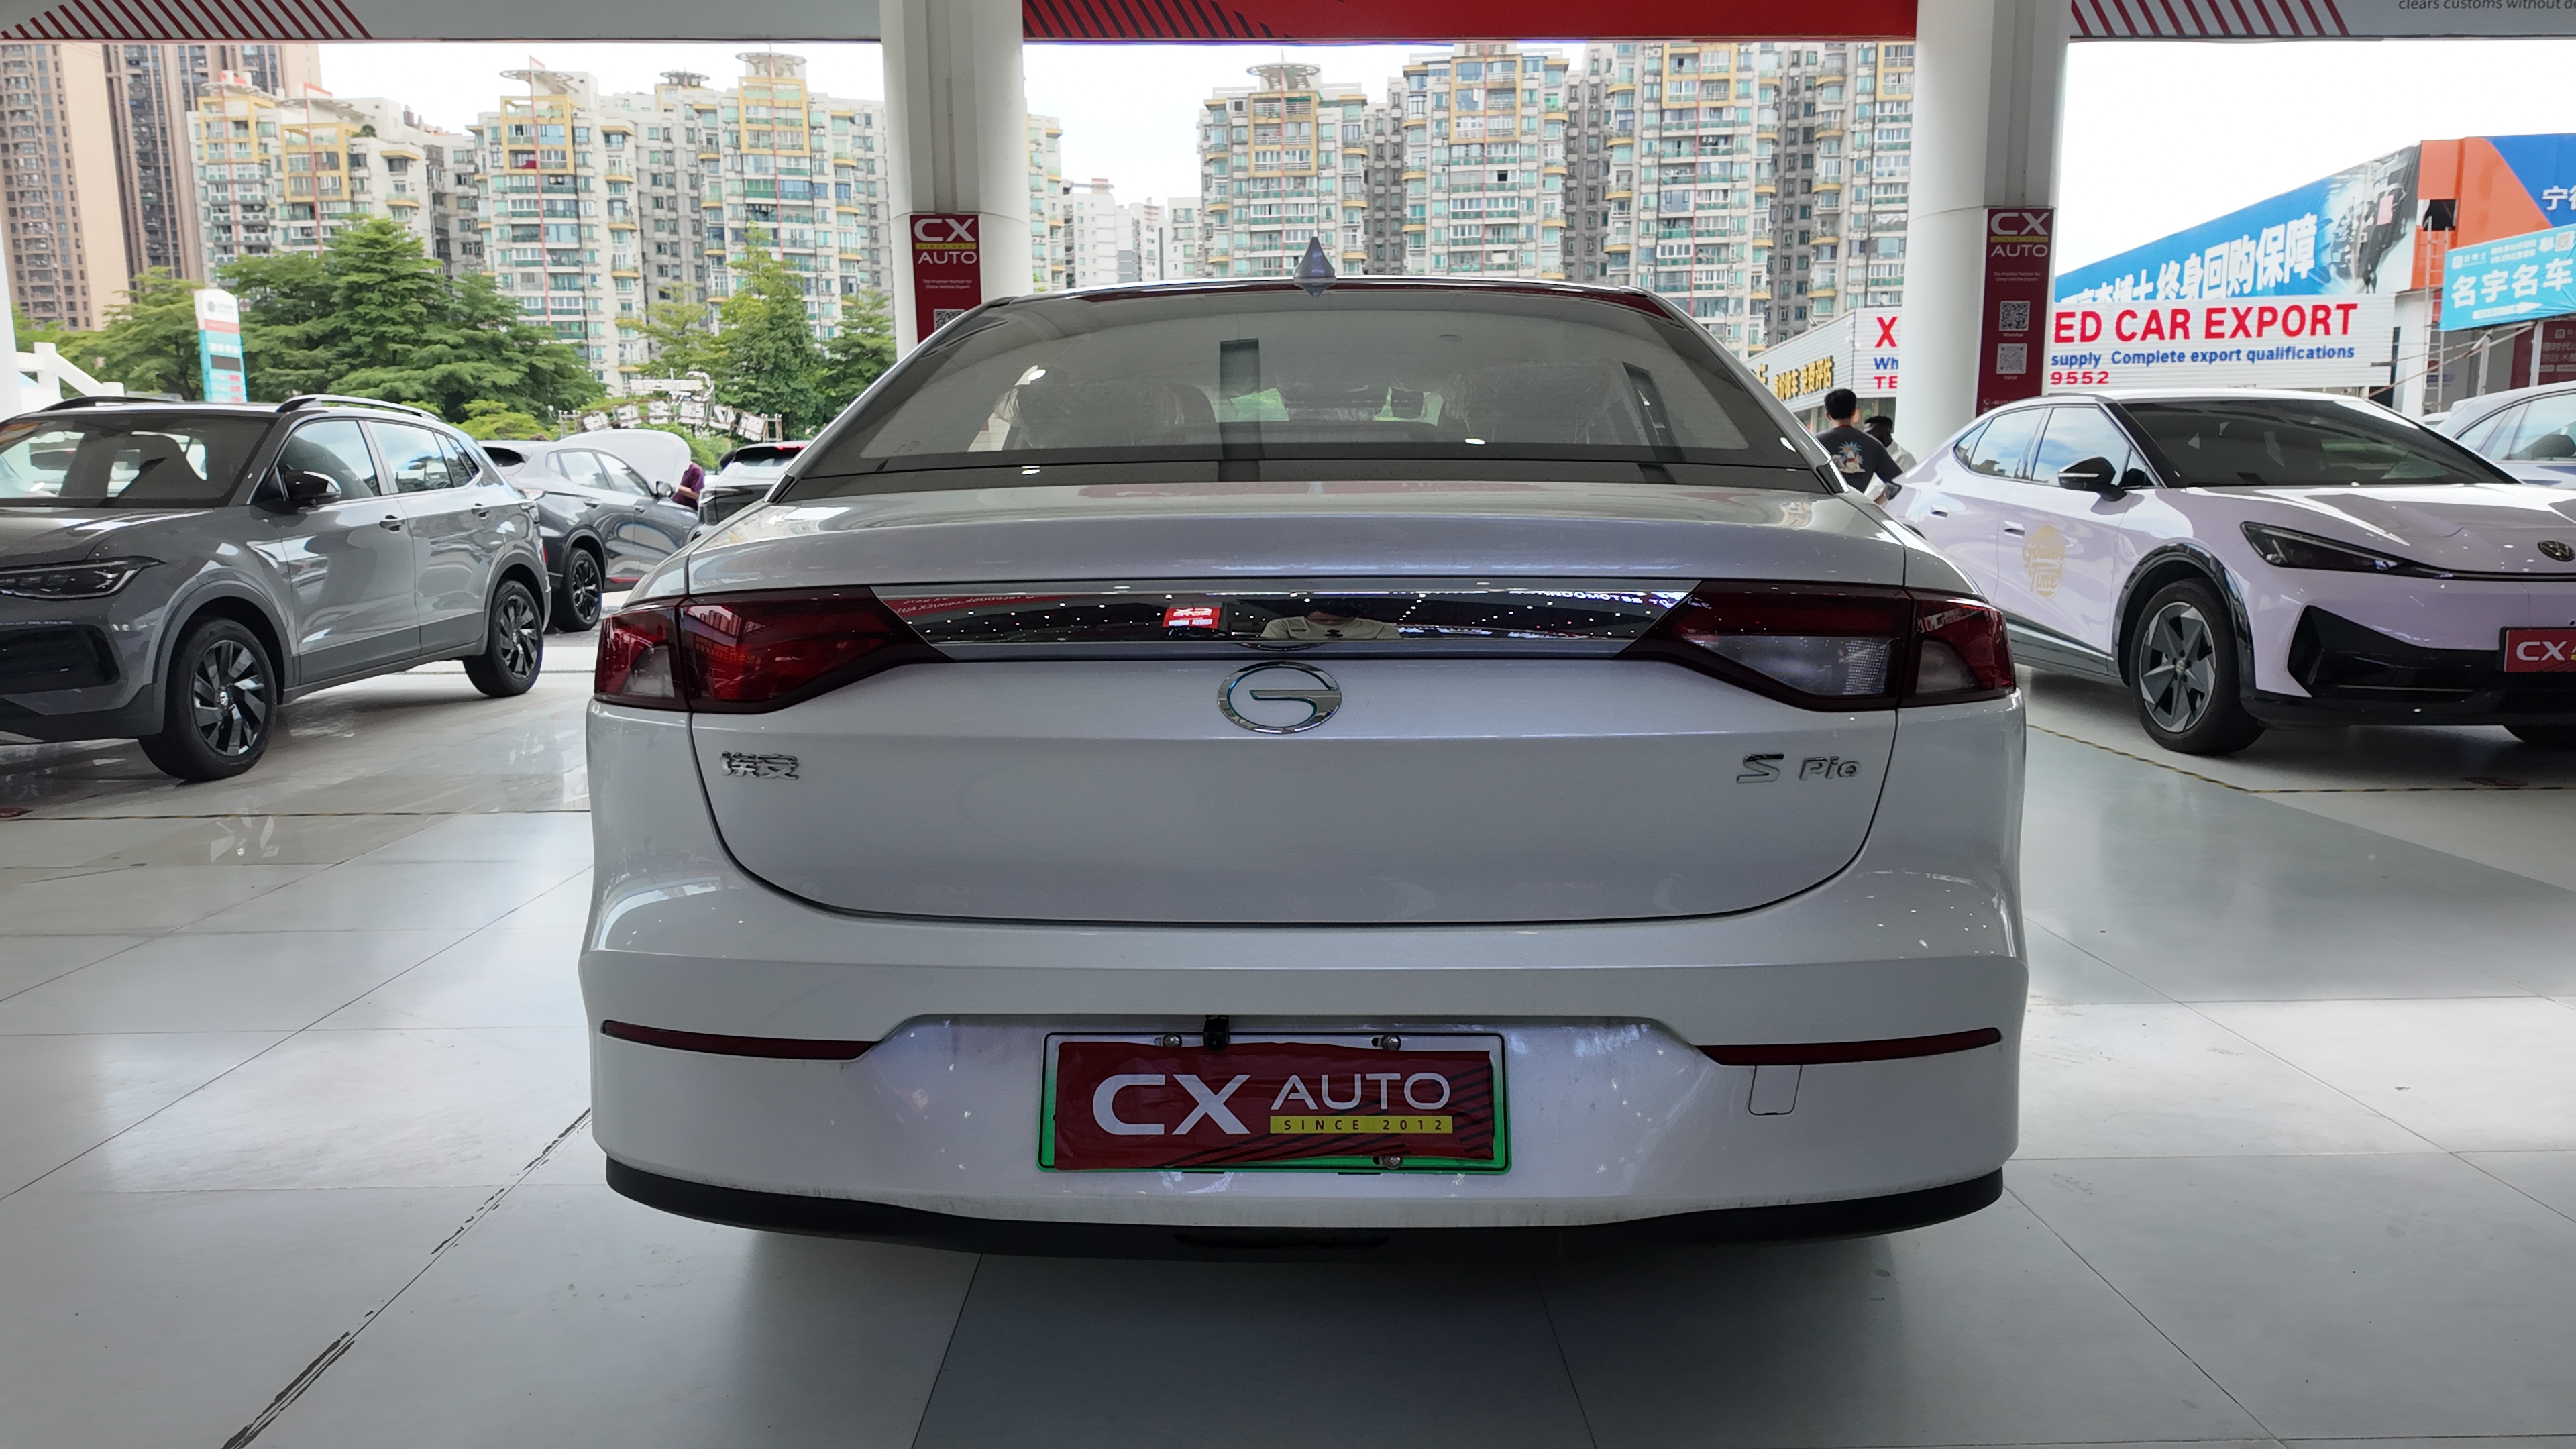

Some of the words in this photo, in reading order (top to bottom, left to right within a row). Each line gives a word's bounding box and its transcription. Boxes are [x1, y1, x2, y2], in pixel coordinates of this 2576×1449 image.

[2398, 0, 2440, 9] clears
[2443, 0, 2502, 9] customs
[2507, 0, 2561, 9] without
[914, 218, 975, 241] CX
[1991, 212, 2050, 235] CX
[918, 251, 977, 264] AUTO
[1990, 244, 2048, 257] AUTO
[2451, 258, 2573, 309] 名宇名车
[2054, 311, 2102, 343] ED
[2115, 309, 2191, 342] CAR
[2204, 303, 2358, 339] EXPORT
[1874, 357, 1899, 370] Wh
[2050, 352, 2102, 368] supply
[2111, 350, 2186, 367] Complete
[2190, 348, 2242, 366] export
[2246, 345, 2355, 364] qualifications
[1873, 376, 1898, 389] TE
[2516, 641, 2567, 661] CX
[1736, 753, 1785, 784] S
[1093, 1074, 1251, 1136] CX
[1270, 1072, 1450, 1110] AUTO
[1284, 1119, 1360, 1131] SINCE
[1383, 1119, 1442, 1131] 2012
